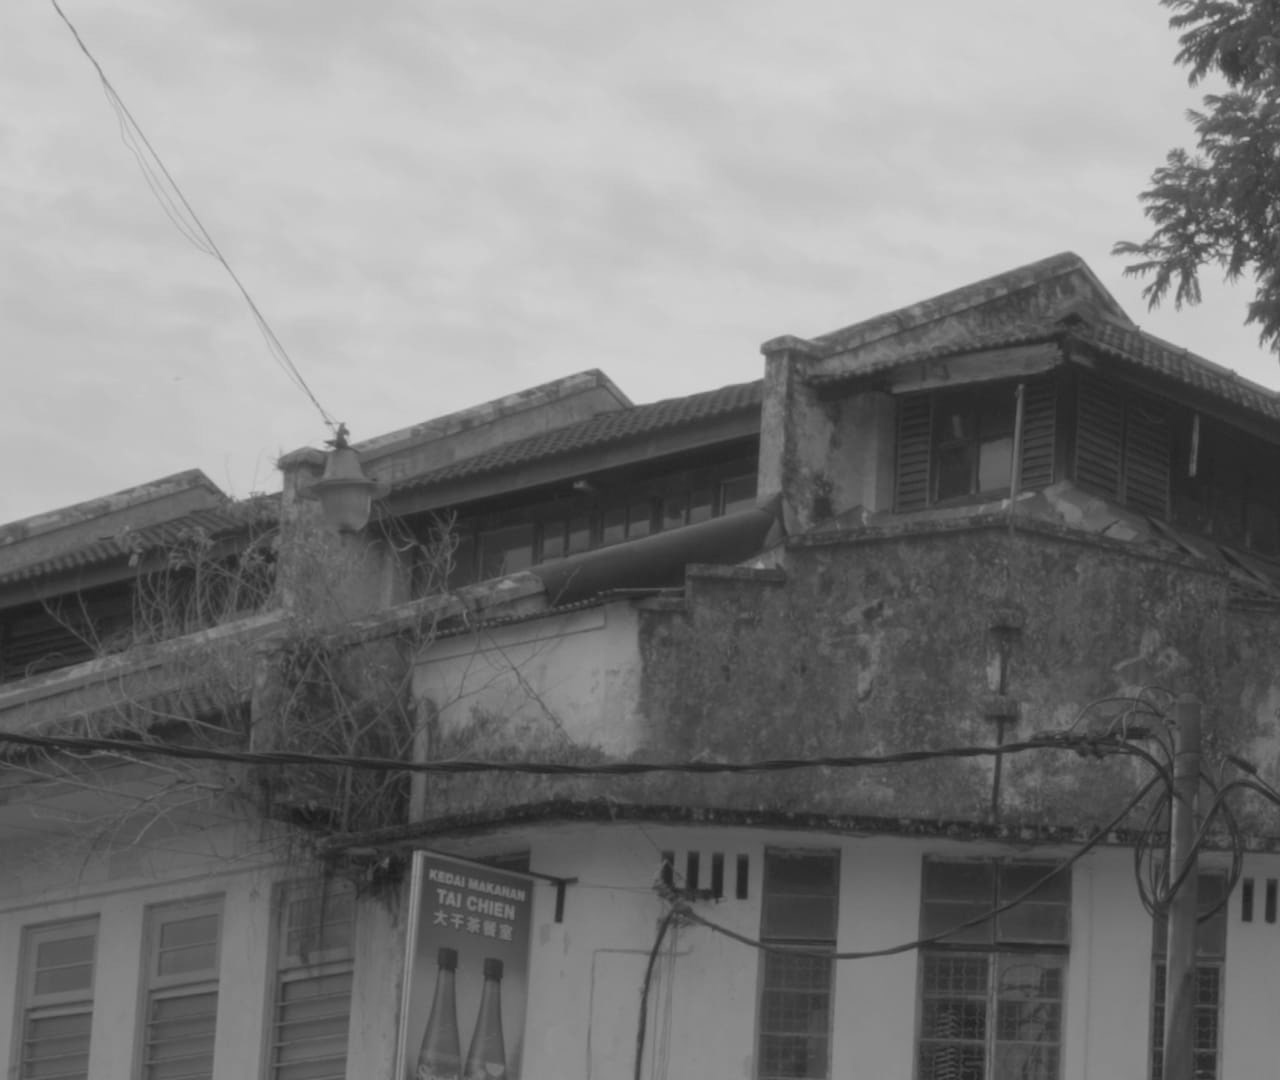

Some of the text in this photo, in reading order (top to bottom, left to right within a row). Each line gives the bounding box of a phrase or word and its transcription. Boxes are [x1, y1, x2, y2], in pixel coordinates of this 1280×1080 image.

[428, 868, 526, 902] KEDAI MAKANAN
[436, 888, 516, 921] TAI CHIEN
